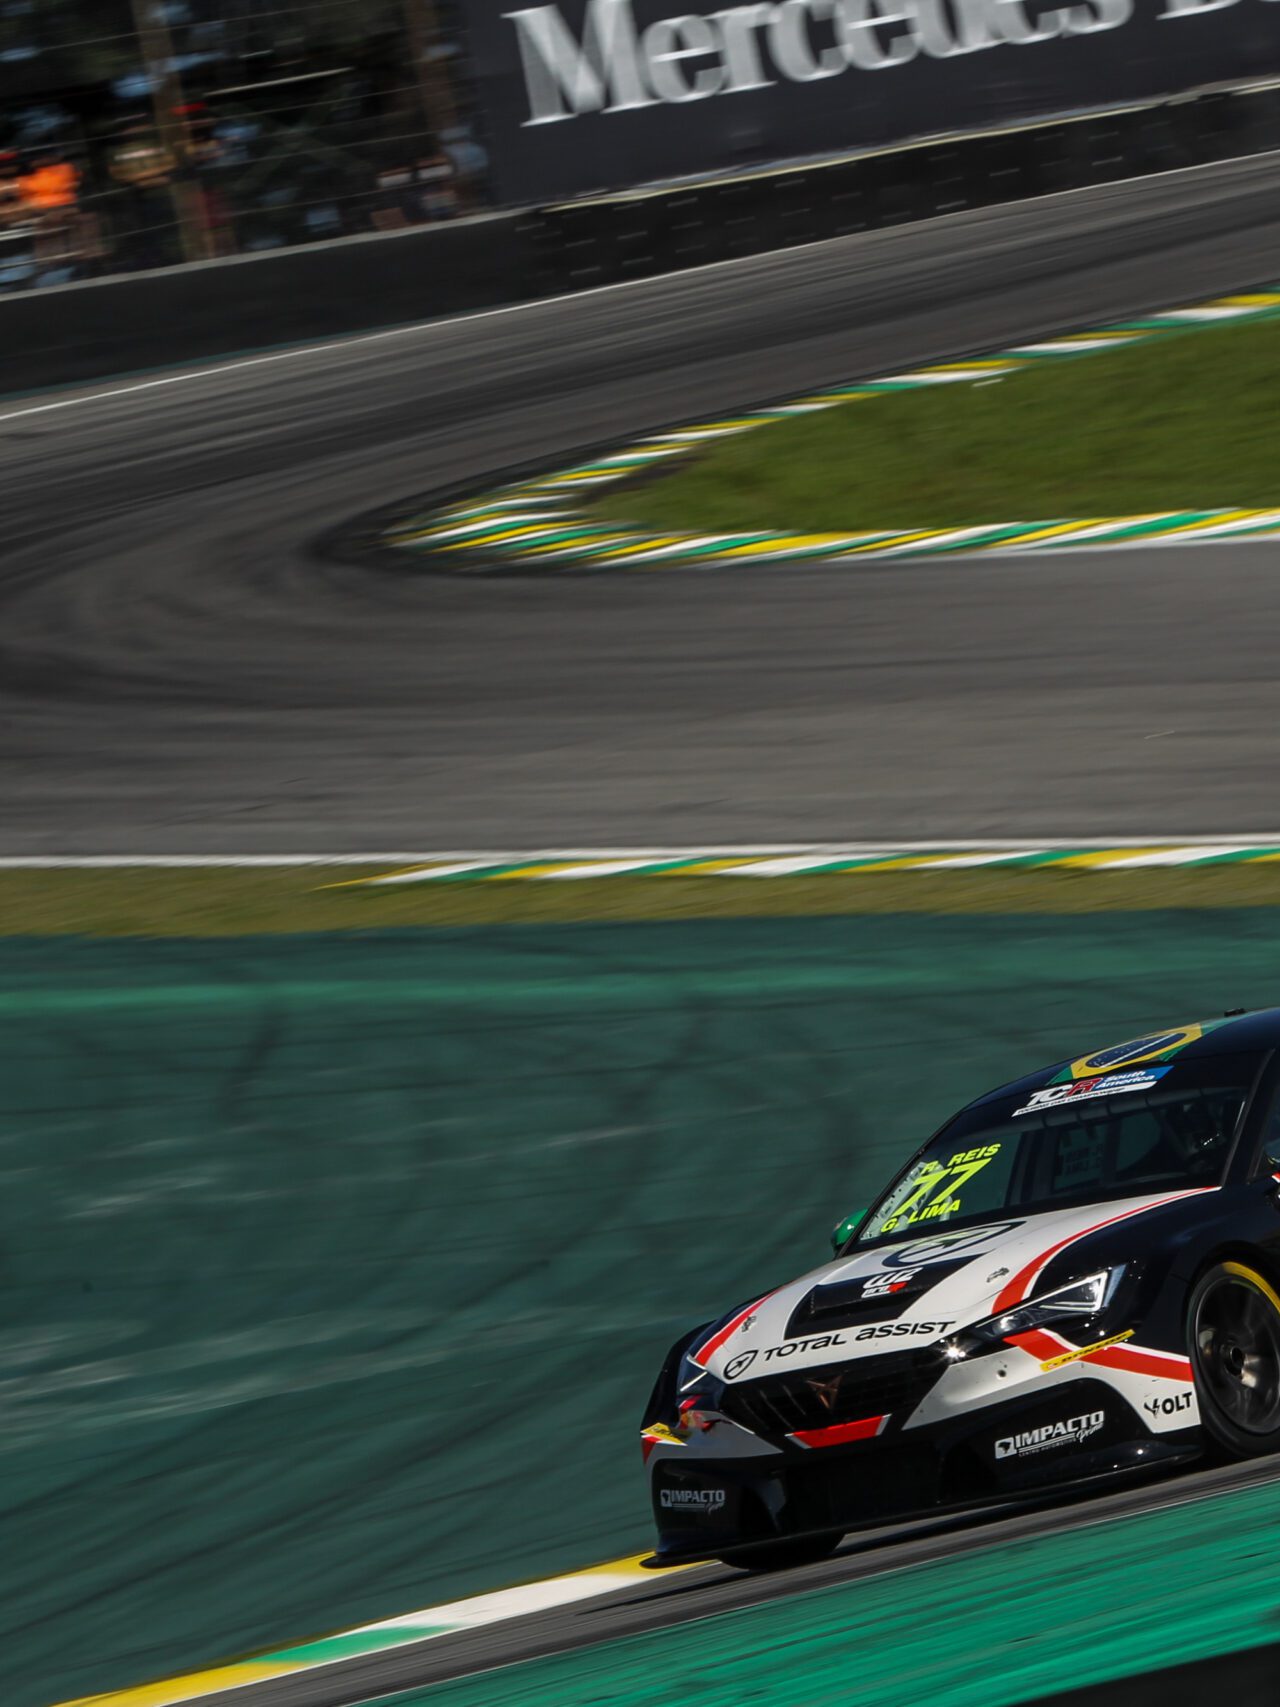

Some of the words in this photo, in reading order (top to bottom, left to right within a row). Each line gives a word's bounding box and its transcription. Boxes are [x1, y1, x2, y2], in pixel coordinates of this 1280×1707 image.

[1097, 1075, 1156, 1089] America
[1104, 1071, 1146, 1083] South
[1027, 1077, 1103, 1107] TCR
[947, 1143, 1002, 1167] REIS
[892, 1157, 992, 1218] 77
[880, 1218, 899, 1233] G.
[908, 1199, 961, 1224] LIMA
[764, 1333, 847, 1362] TOTAL
[1144, 1391, 1193, 1418] VOLT
[1015, 1410, 1104, 1448] IMPACTO
[672, 1489, 726, 1503] IMPACTO
